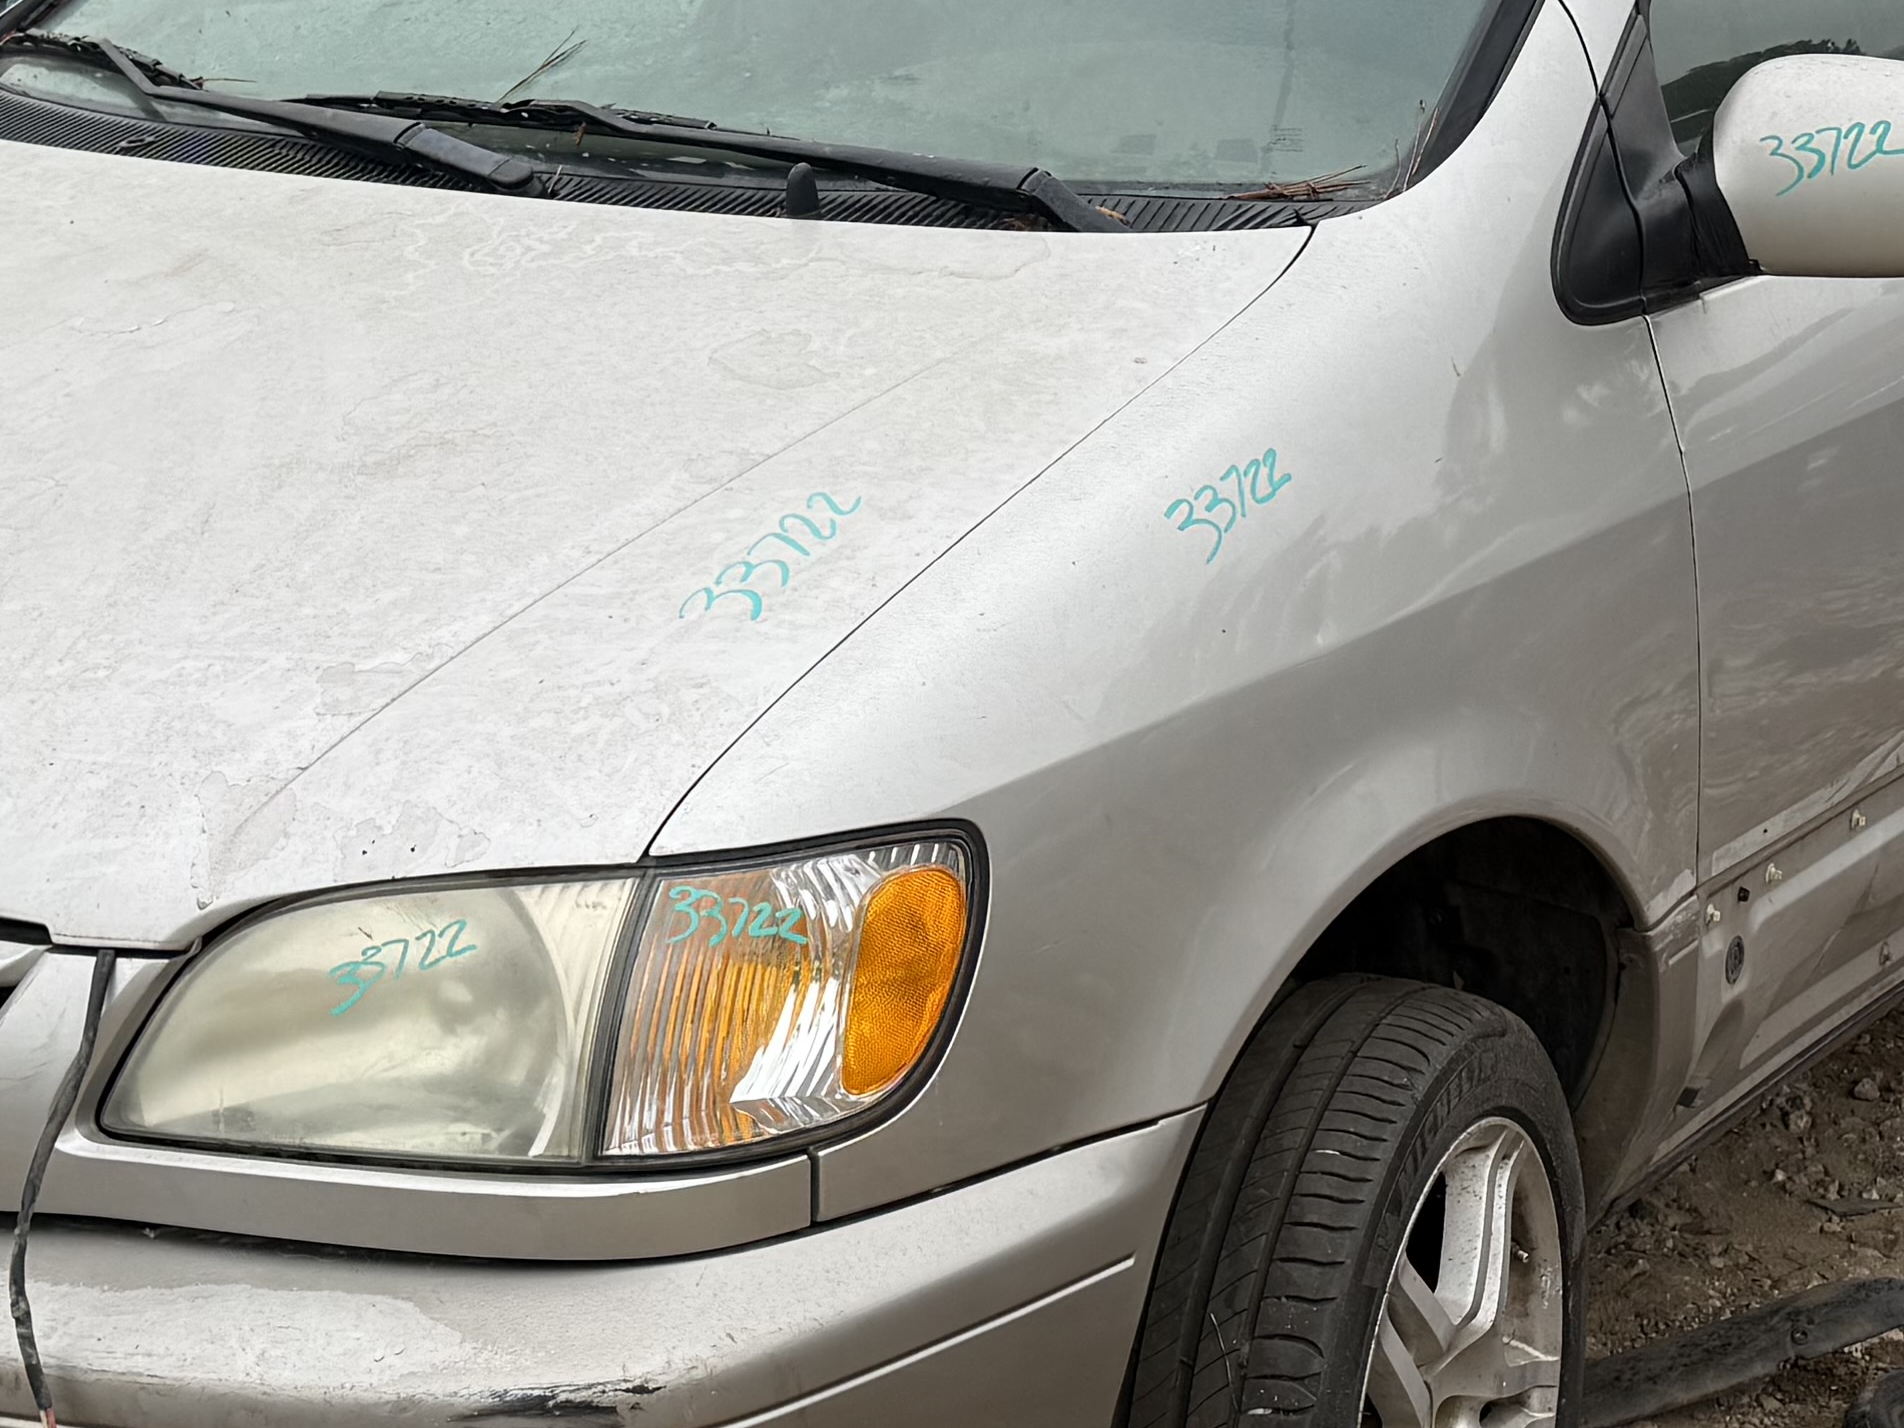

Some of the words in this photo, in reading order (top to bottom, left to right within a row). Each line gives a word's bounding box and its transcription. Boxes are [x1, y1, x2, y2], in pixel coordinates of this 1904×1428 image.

[679, 491, 862, 622] 33722
[1164, 447, 1292, 565] 33722
[328, 918, 478, 1017] 33722
[666, 885, 809, 948] 33722
